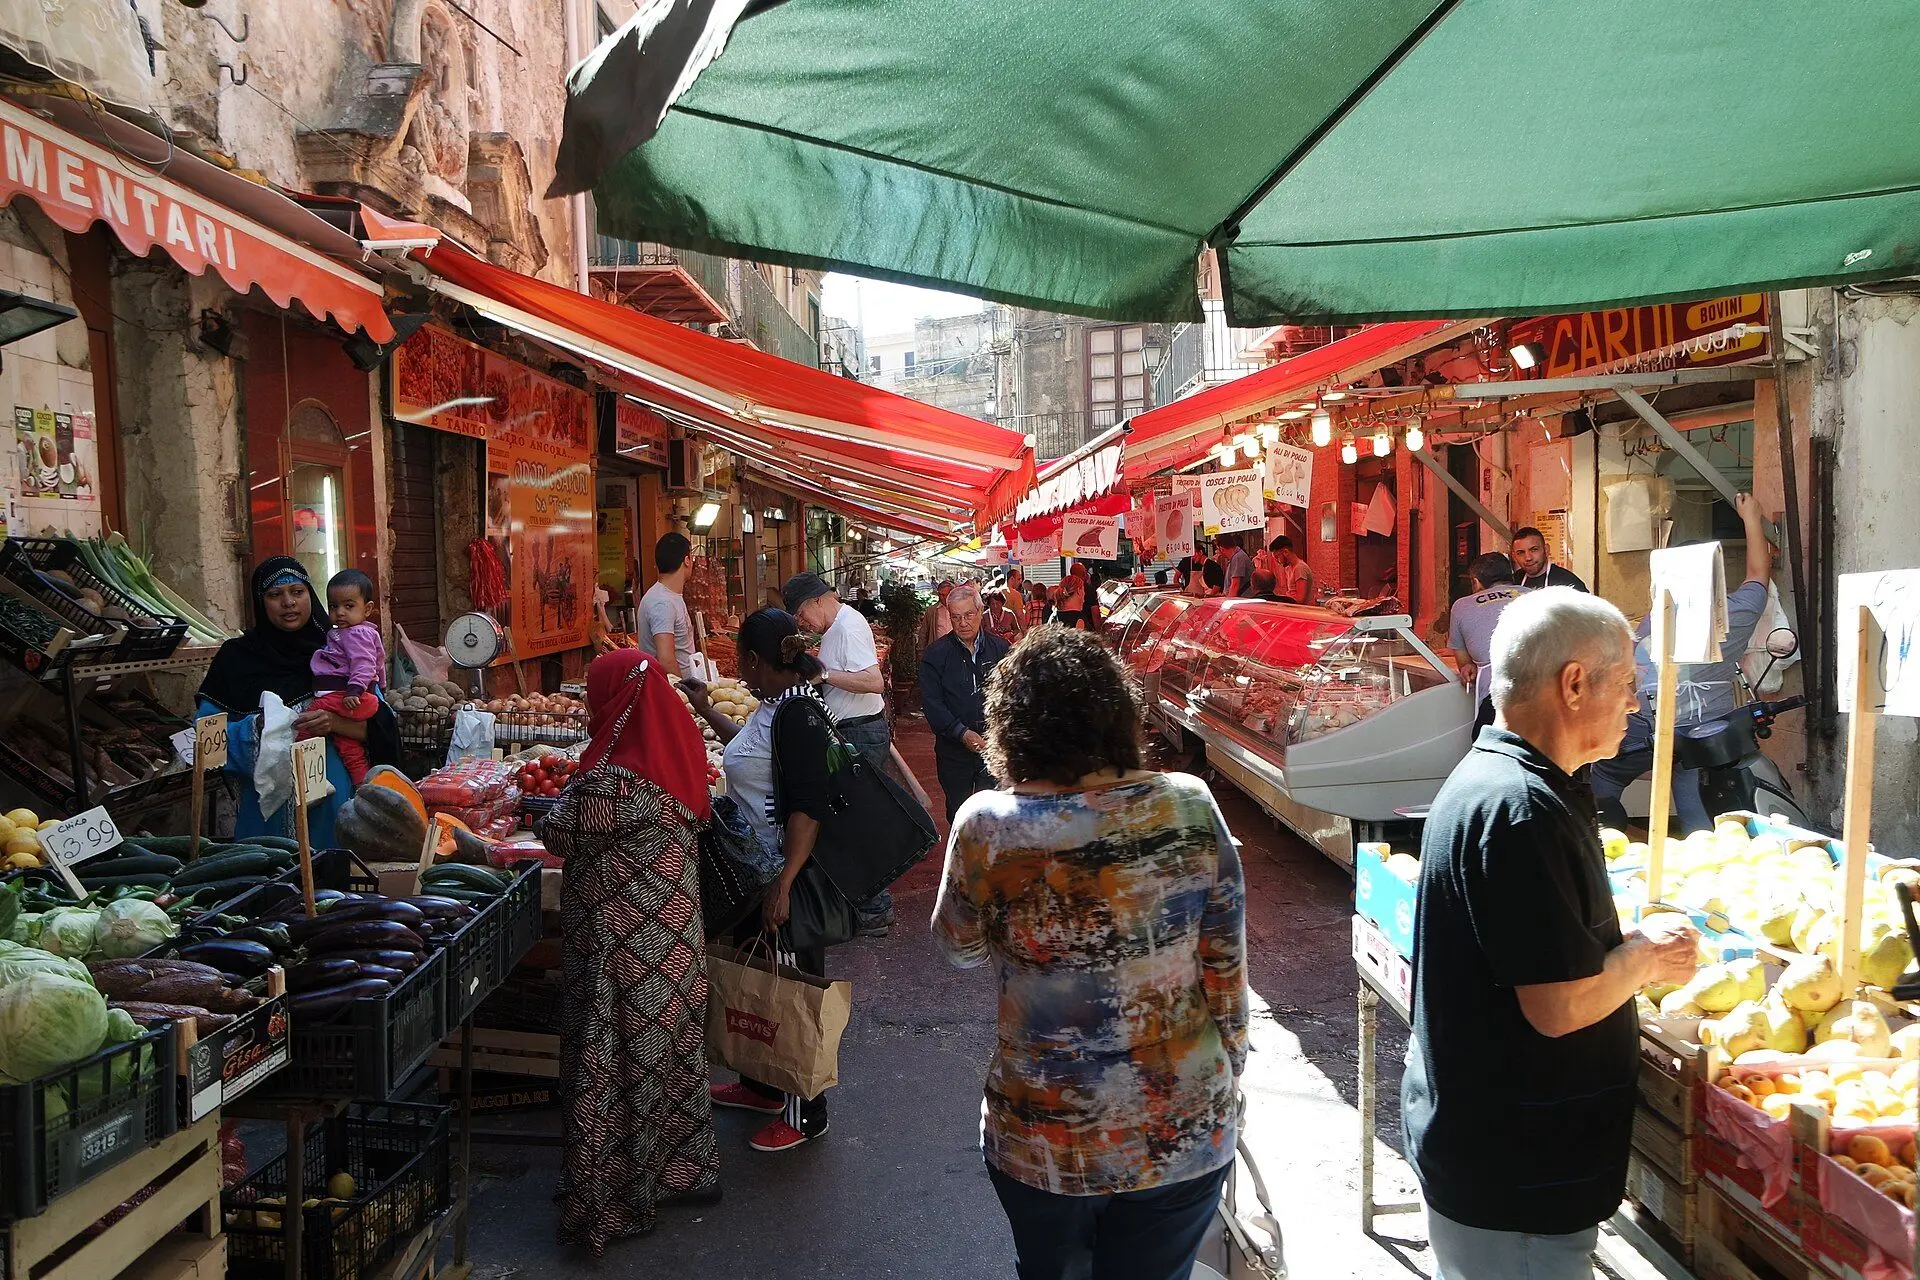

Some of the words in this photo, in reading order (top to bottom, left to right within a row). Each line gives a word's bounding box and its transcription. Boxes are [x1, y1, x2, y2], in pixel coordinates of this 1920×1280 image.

[4, 124, 236, 270] MENTARI
[1701, 296, 1742, 324] BOVINI
[431, 415, 438, 425] E
[446, 417, 486, 436] TANTO
[492, 429, 525, 448] ALTRO
[1273, 447, 1283, 456] ALI
[1284, 450, 1290, 458] DI
[1290, 452, 1308, 463] POLLO
[514, 459, 548, 488] ODORI
[556, 466, 589, 496] SAPORI
[1206, 477, 1227, 487] COSCE
[1228, 476, 1236, 485] DI
[1236, 474, 1257, 483] POLLO
[1068, 517, 1088, 525] COSTATA
[1096, 519, 1115, 527] MAIALE
[1247, 514, 1261, 526] kg.
[1101, 548, 1113, 558] kg.
[730, 1015, 772, 1038] Levi's
[512, 1091, 532, 1105] DA
